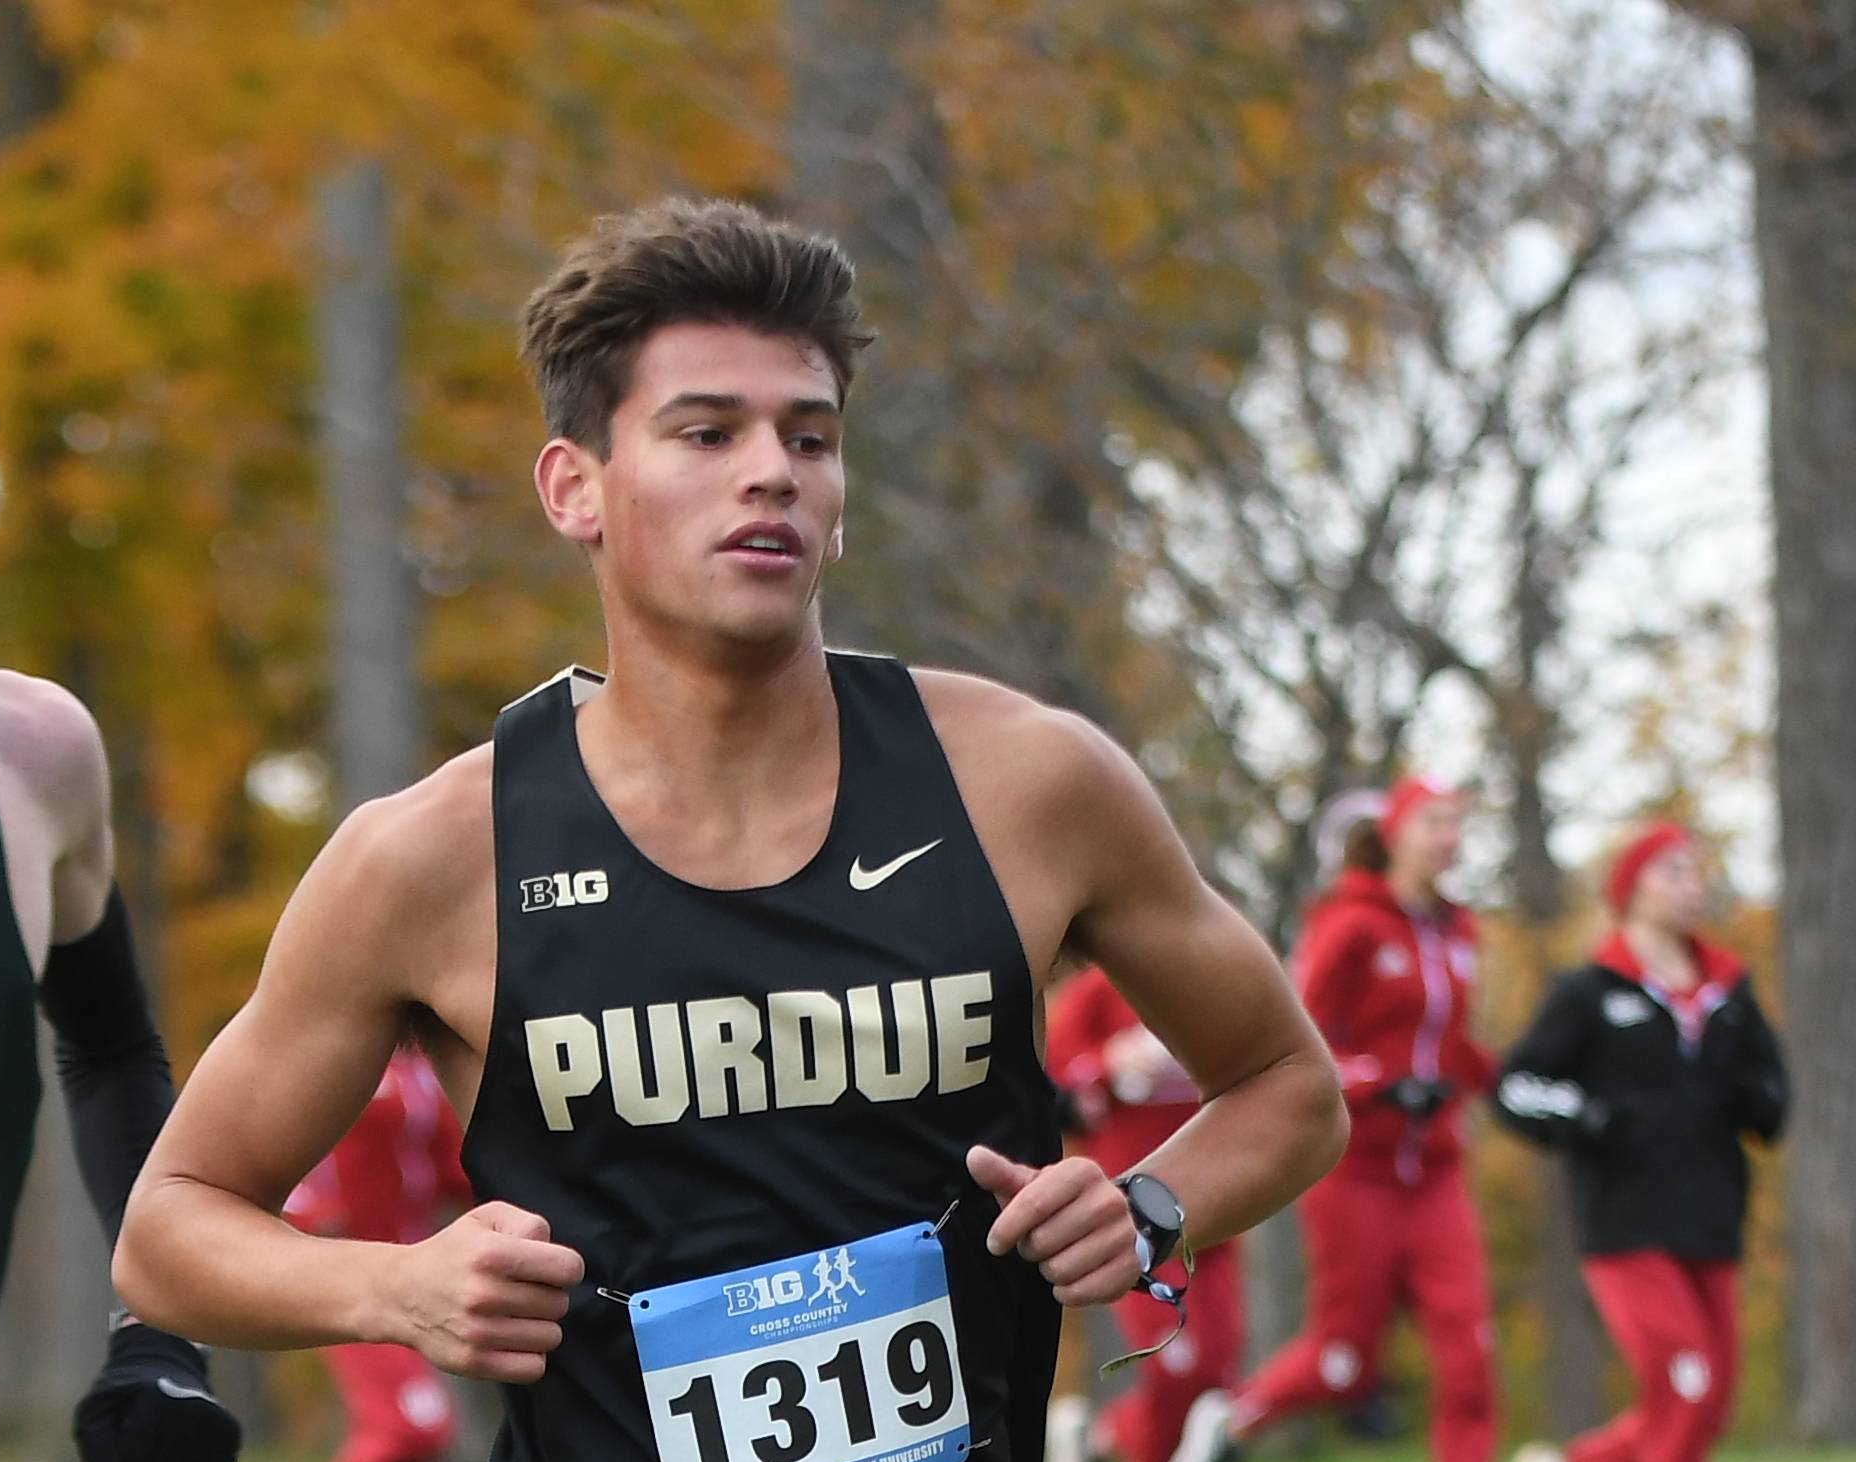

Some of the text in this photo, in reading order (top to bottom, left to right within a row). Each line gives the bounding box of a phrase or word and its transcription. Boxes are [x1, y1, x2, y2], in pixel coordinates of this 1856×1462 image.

[524, 971, 994, 1132] PURDUE
[750, 1303, 848, 1335] CROSS COUNTRY
[763, 1317, 839, 1340] CHAMPIONSHIPS
